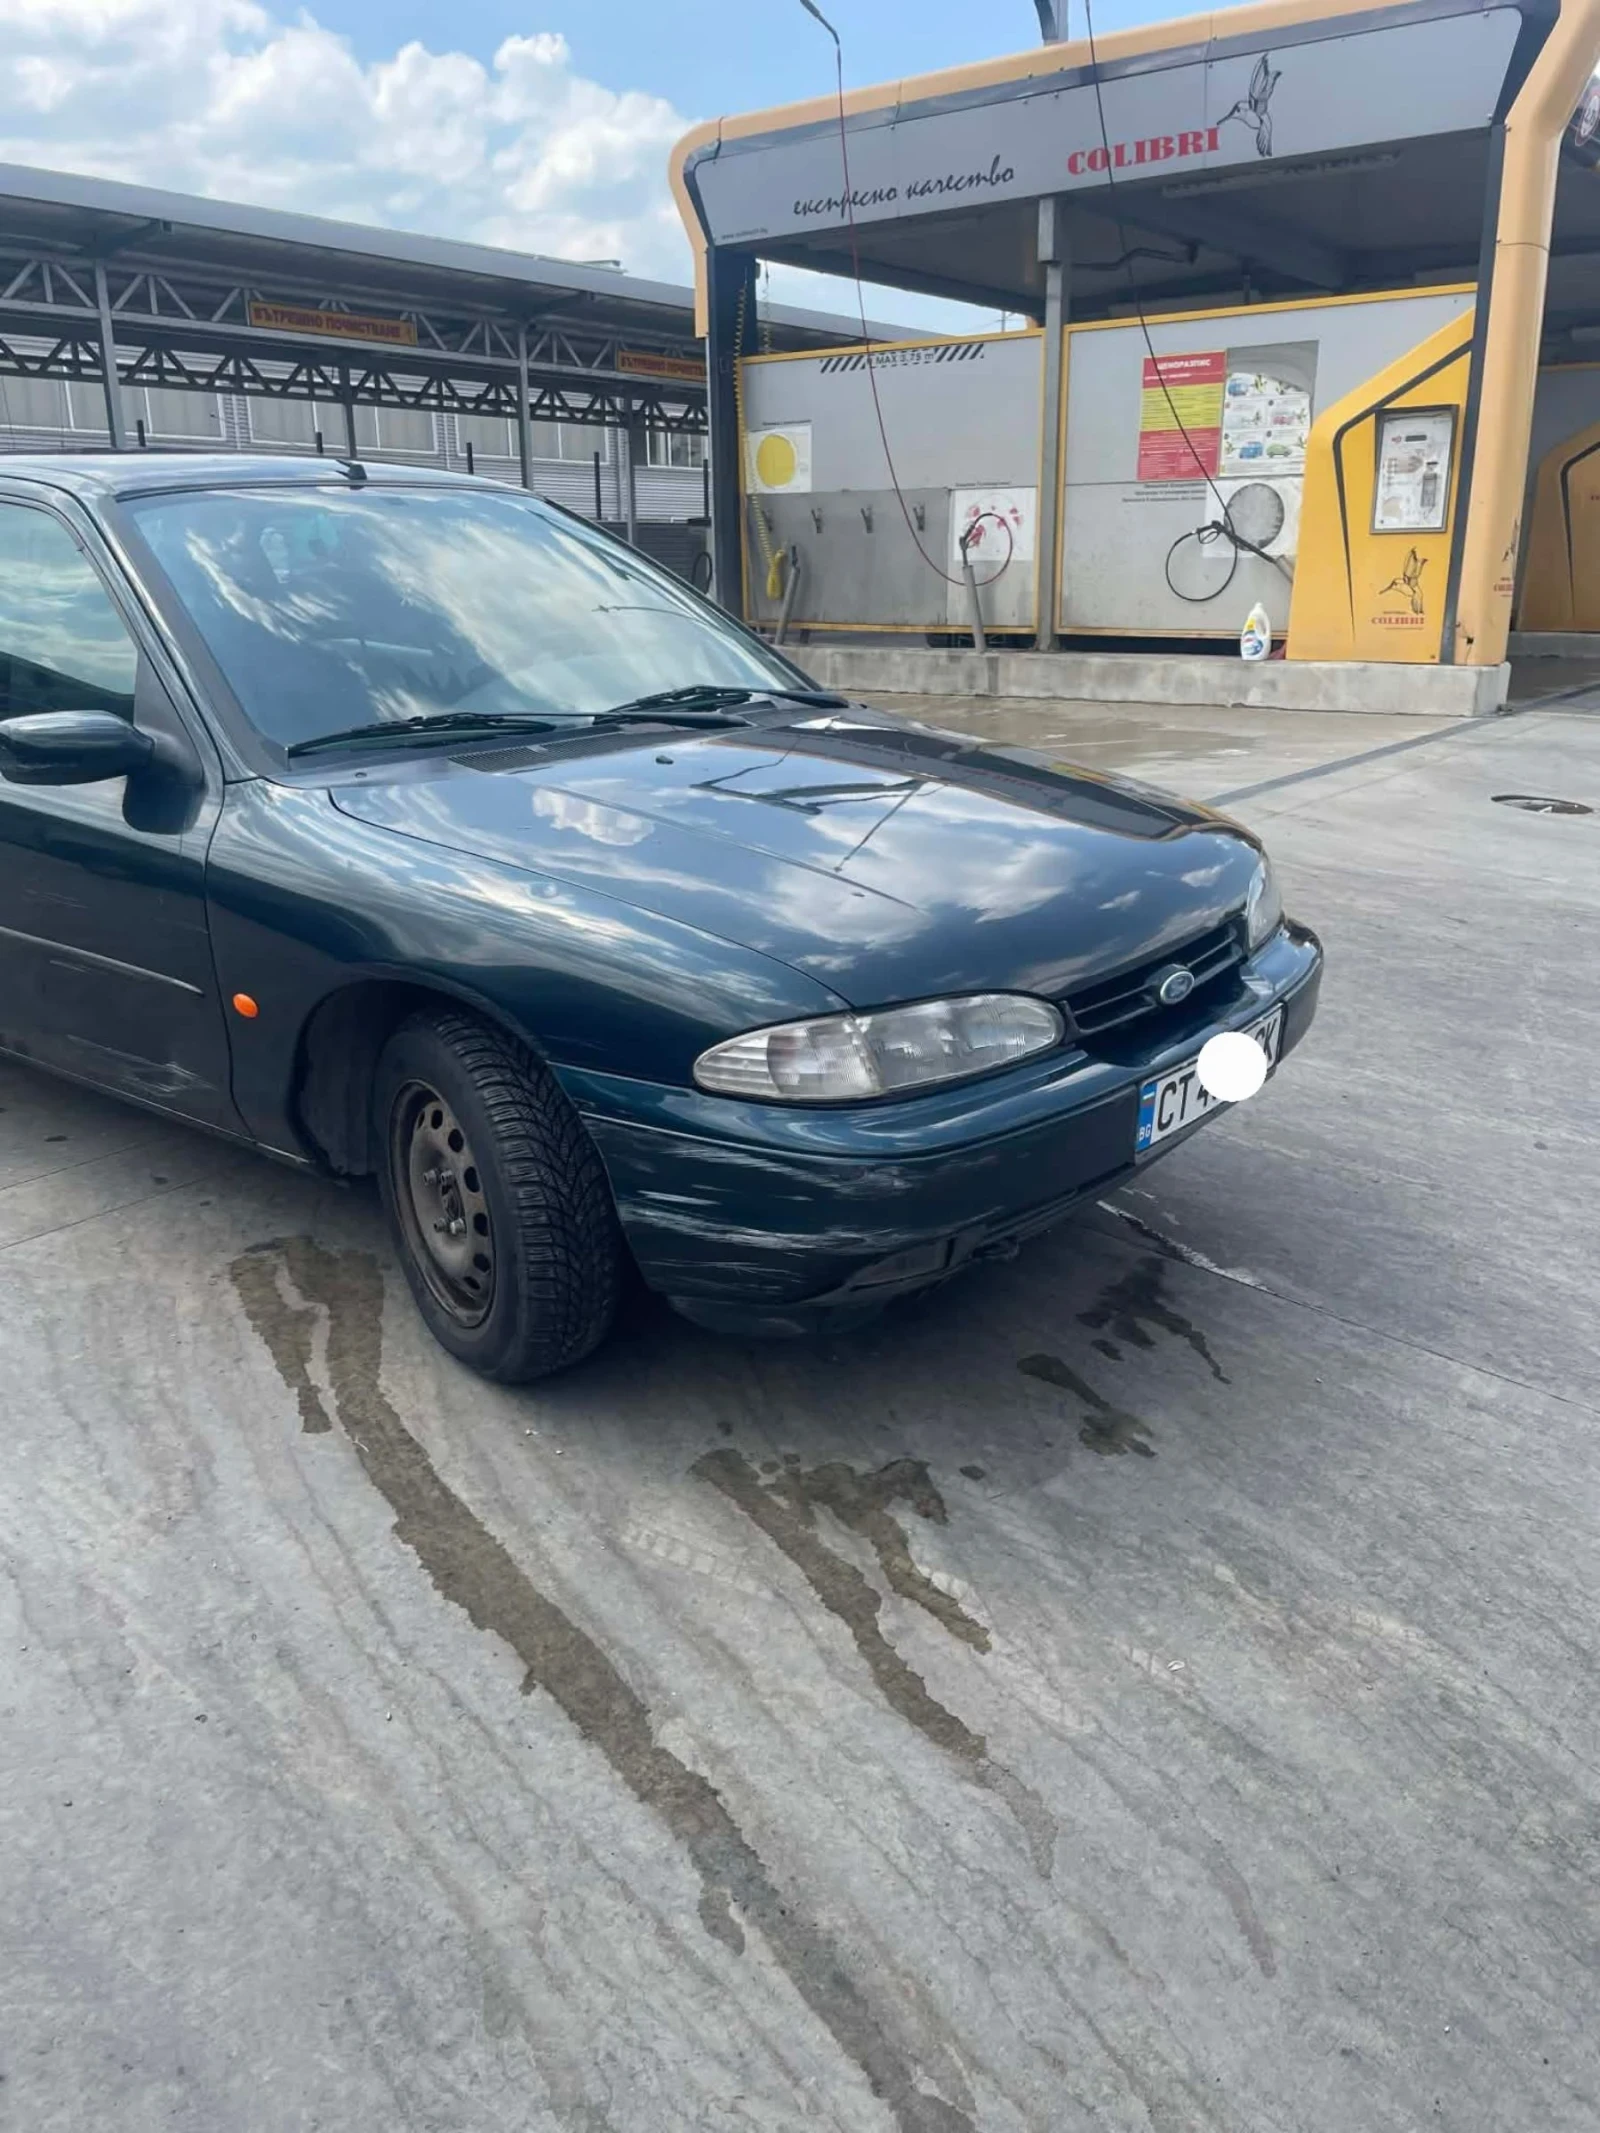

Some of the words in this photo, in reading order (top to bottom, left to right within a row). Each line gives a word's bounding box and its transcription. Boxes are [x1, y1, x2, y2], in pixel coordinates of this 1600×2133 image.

[1067, 126, 1220, 175] COLIBRI
[792, 186, 898, 218] експресно
[906, 154, 1015, 199] качество
[875, 353, 897, 365] MAX
[1138, 1123, 1152, 1142] BG
